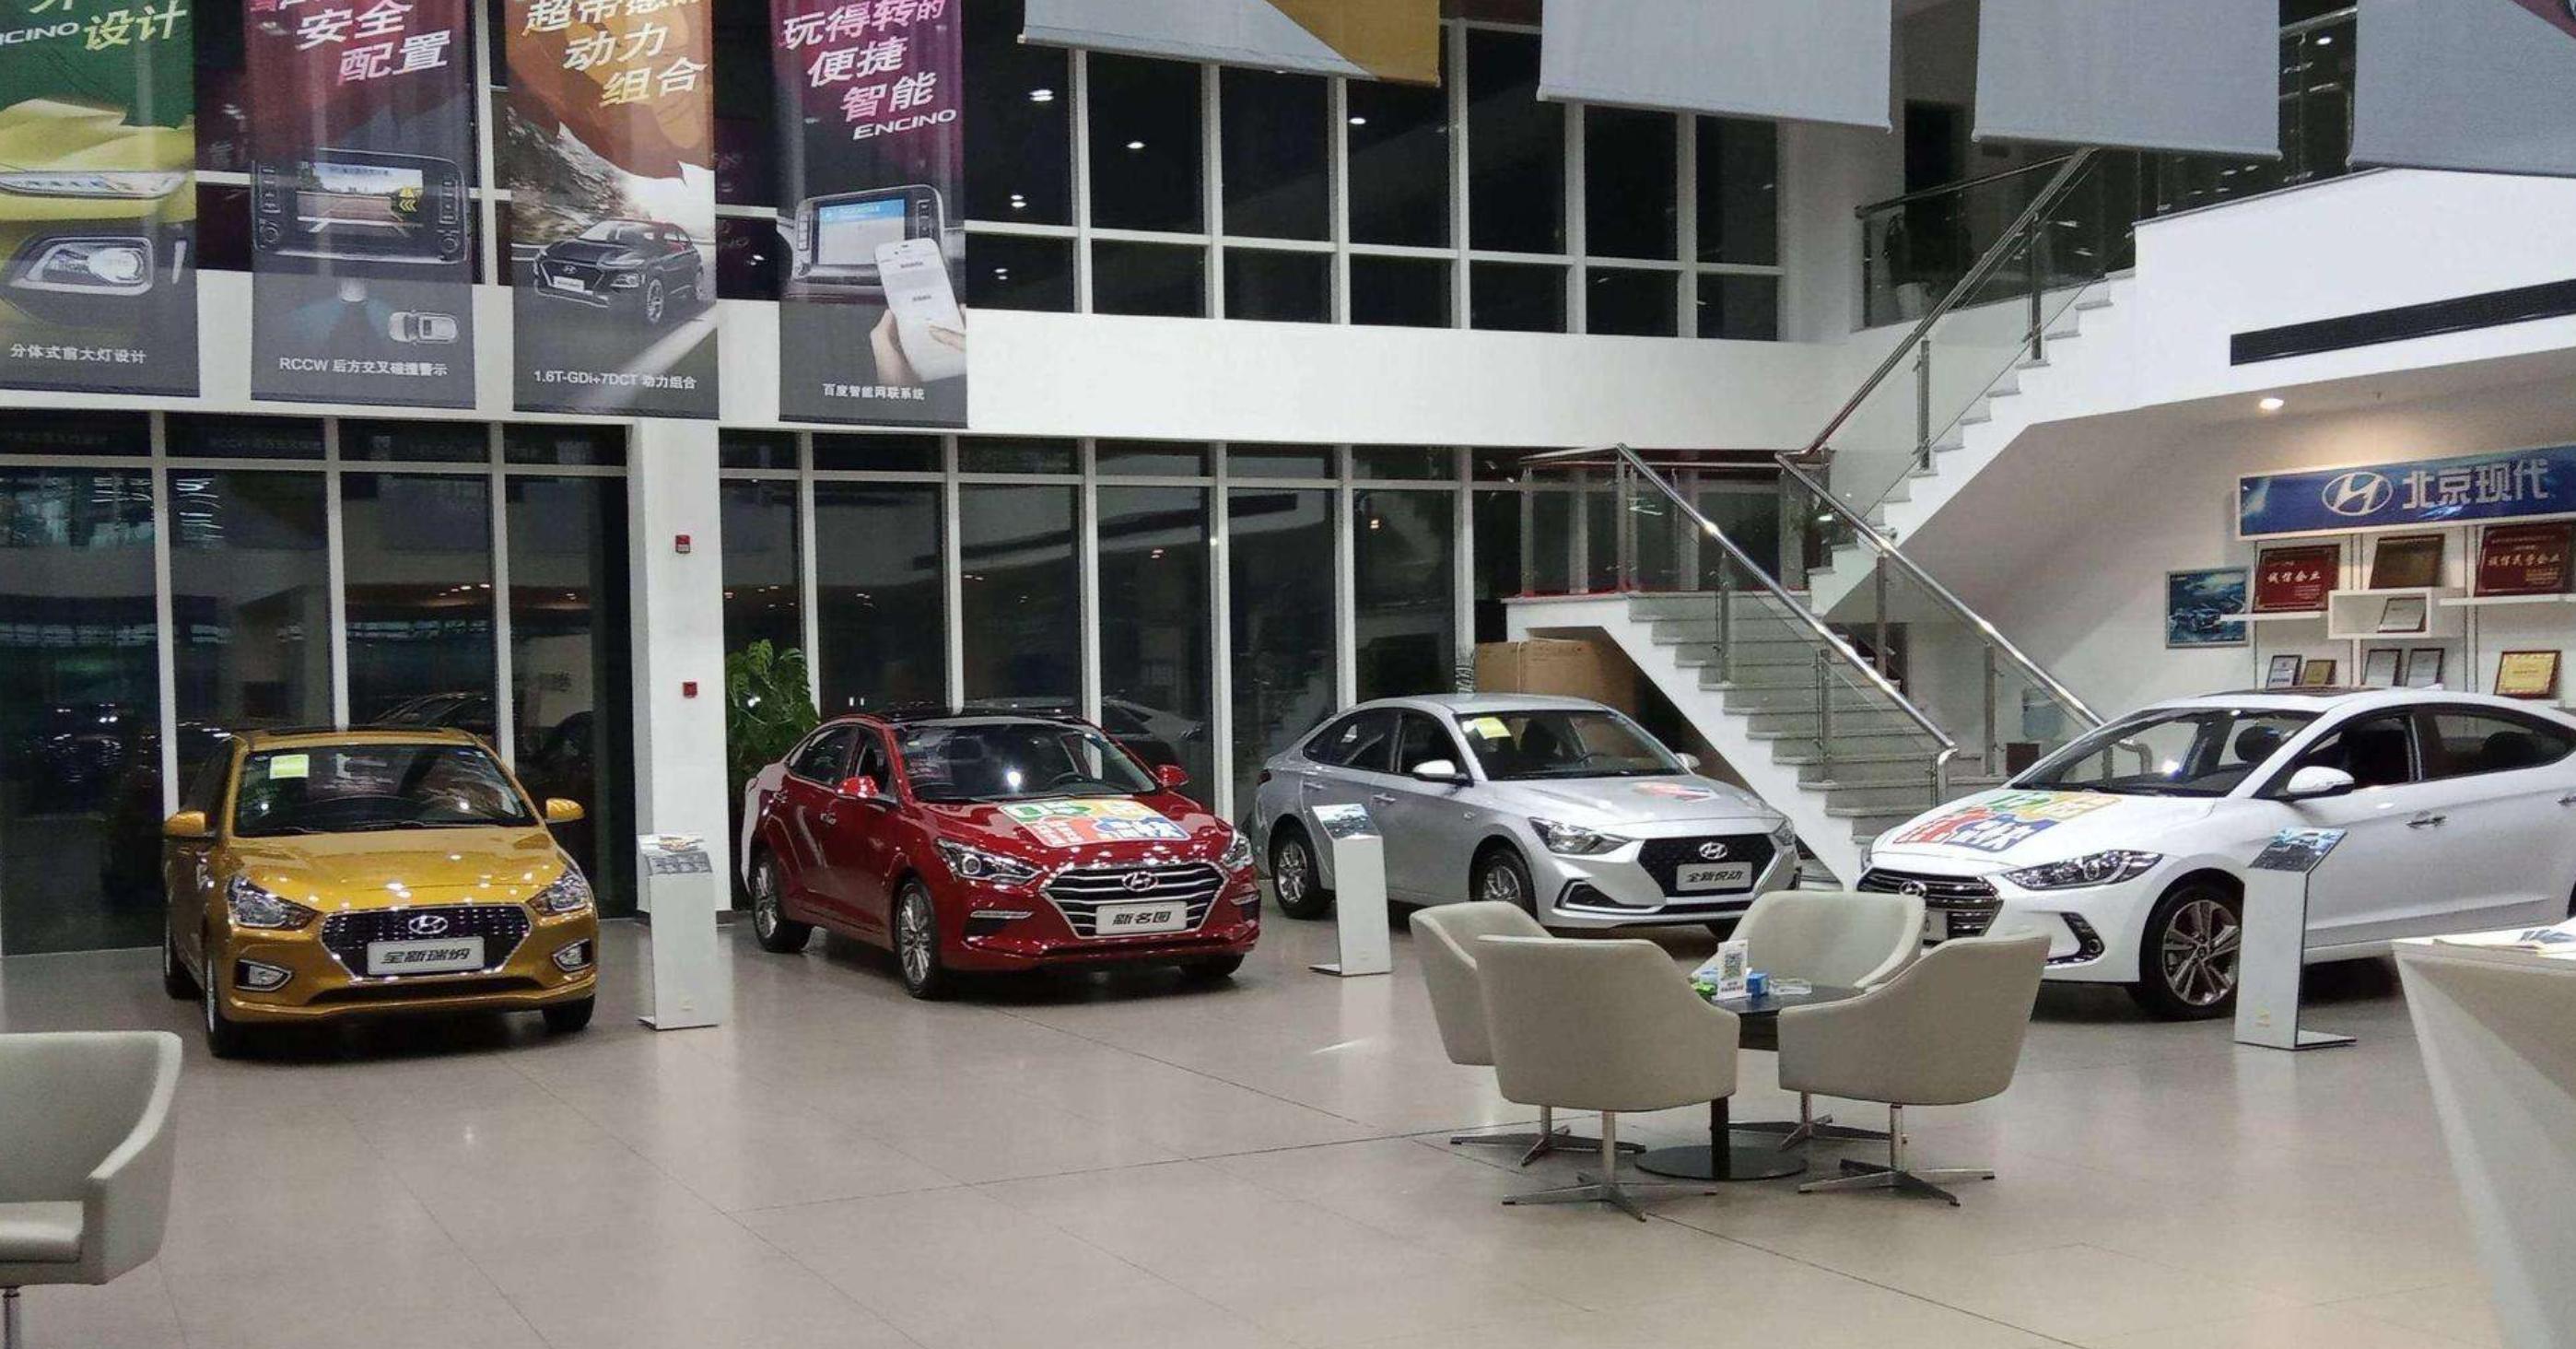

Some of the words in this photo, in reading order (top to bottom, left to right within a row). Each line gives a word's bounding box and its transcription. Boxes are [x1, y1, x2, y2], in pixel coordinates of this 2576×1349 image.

[0, 22, 78, 45] CINO
[83, 0, 187, 50] 设计
[295, 0, 413, 51] 安全
[562, 22, 669, 71] 动力
[781, 0, 946, 50] 玩得转的
[337, 29, 451, 85] 配置
[599, 56, 708, 107] 组合
[807, 37, 909, 88] 便捷
[840, 72, 937, 122] 智能
[852, 109, 957, 140] ENCINO
[10, 343, 147, 364] 分体式前大灯设计
[279, 357, 329, 371] RCCW
[643, 374, 697, 390] 动力组合
[2402, 459, 2549, 510] 北京现代
[1687, 870, 1744, 883] 全新悦动
[1112, 911, 1172, 926] 新名图
[381, 948, 471, 964] 全新瑞纳
